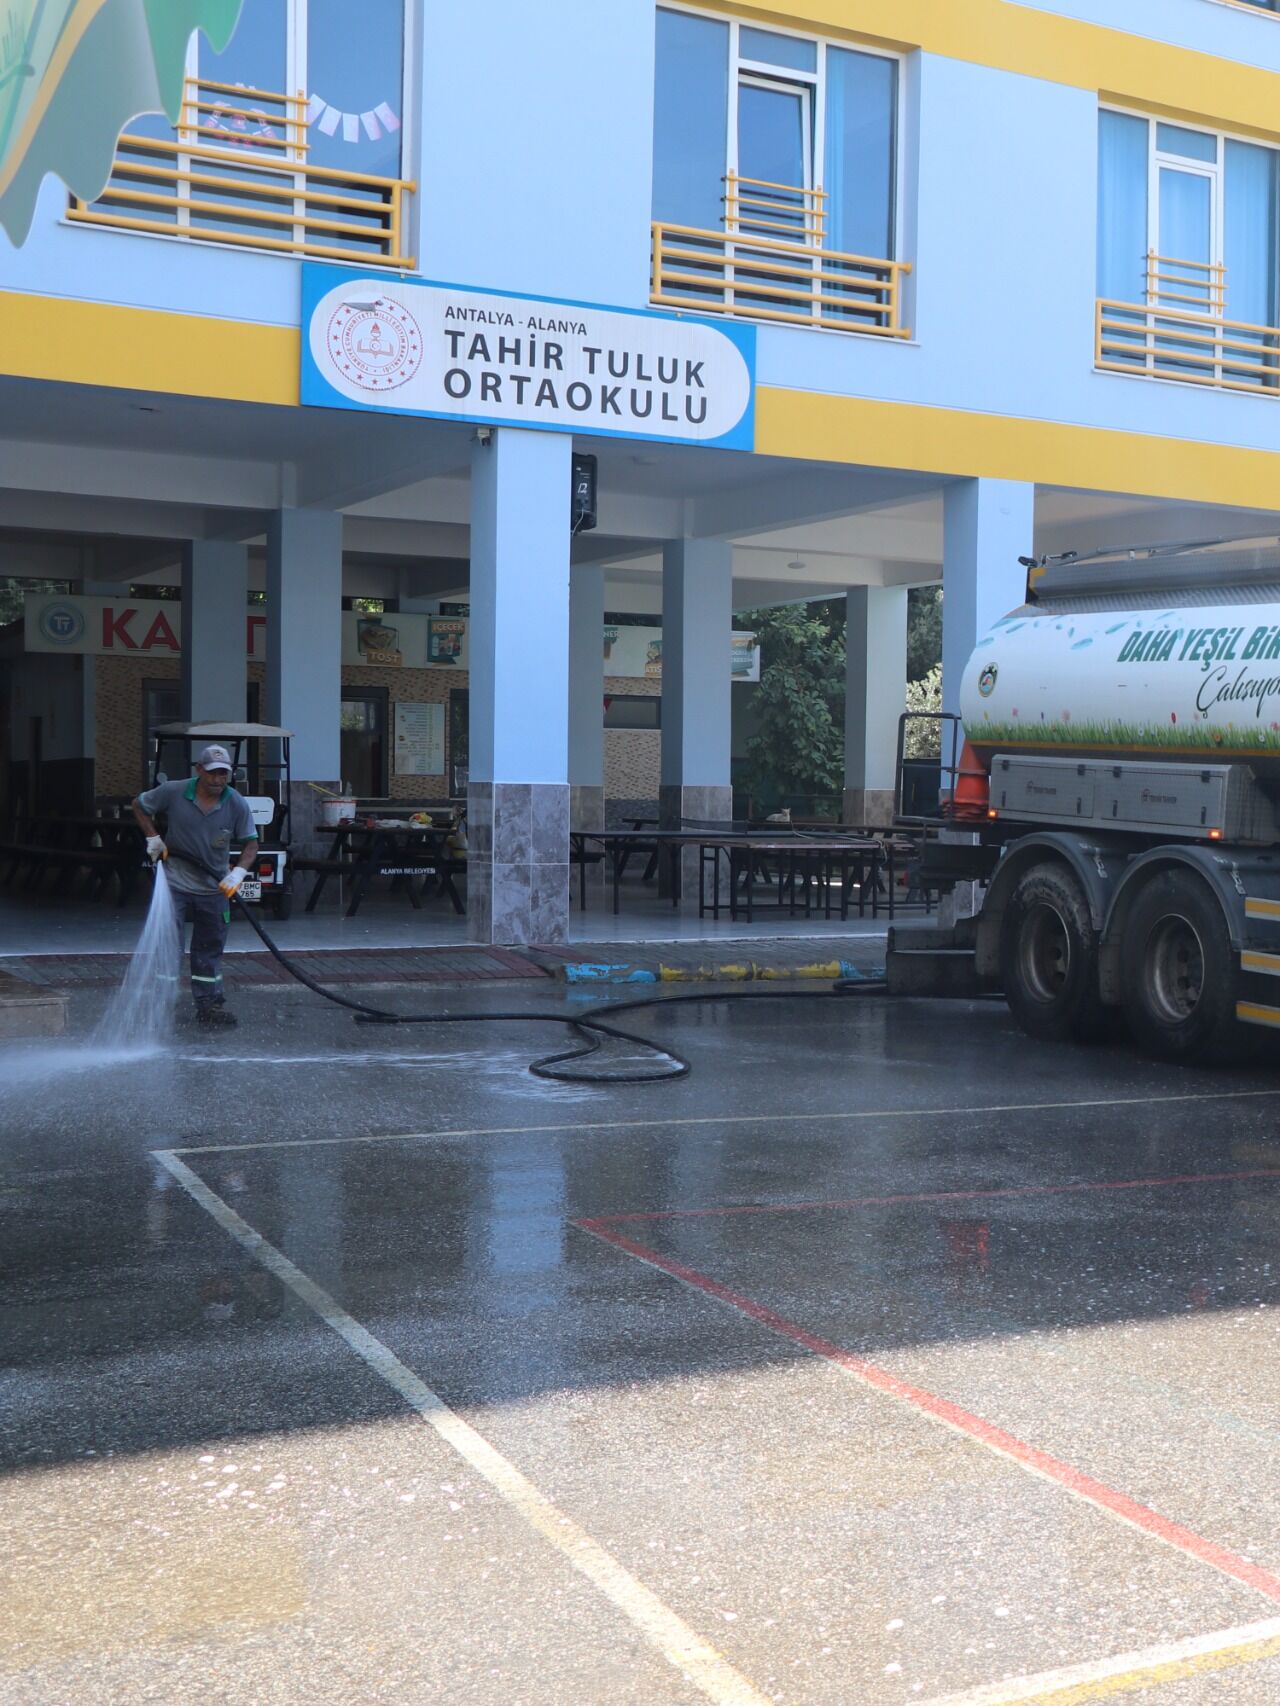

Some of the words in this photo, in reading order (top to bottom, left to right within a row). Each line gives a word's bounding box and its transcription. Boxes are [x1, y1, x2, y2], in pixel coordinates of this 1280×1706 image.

[445, 306, 514, 327] ANTALYA
[527, 316, 587, 336] ALANYA
[444, 329, 564, 371] TAHİR
[582, 346, 705, 388] TULUK
[444, 368, 707, 424] ORTAOKULU
[370, 652, 399, 662] TOST
[1117, 630, 1179, 663] DAHA
[1178, 627, 1246, 672] YEŞİL
